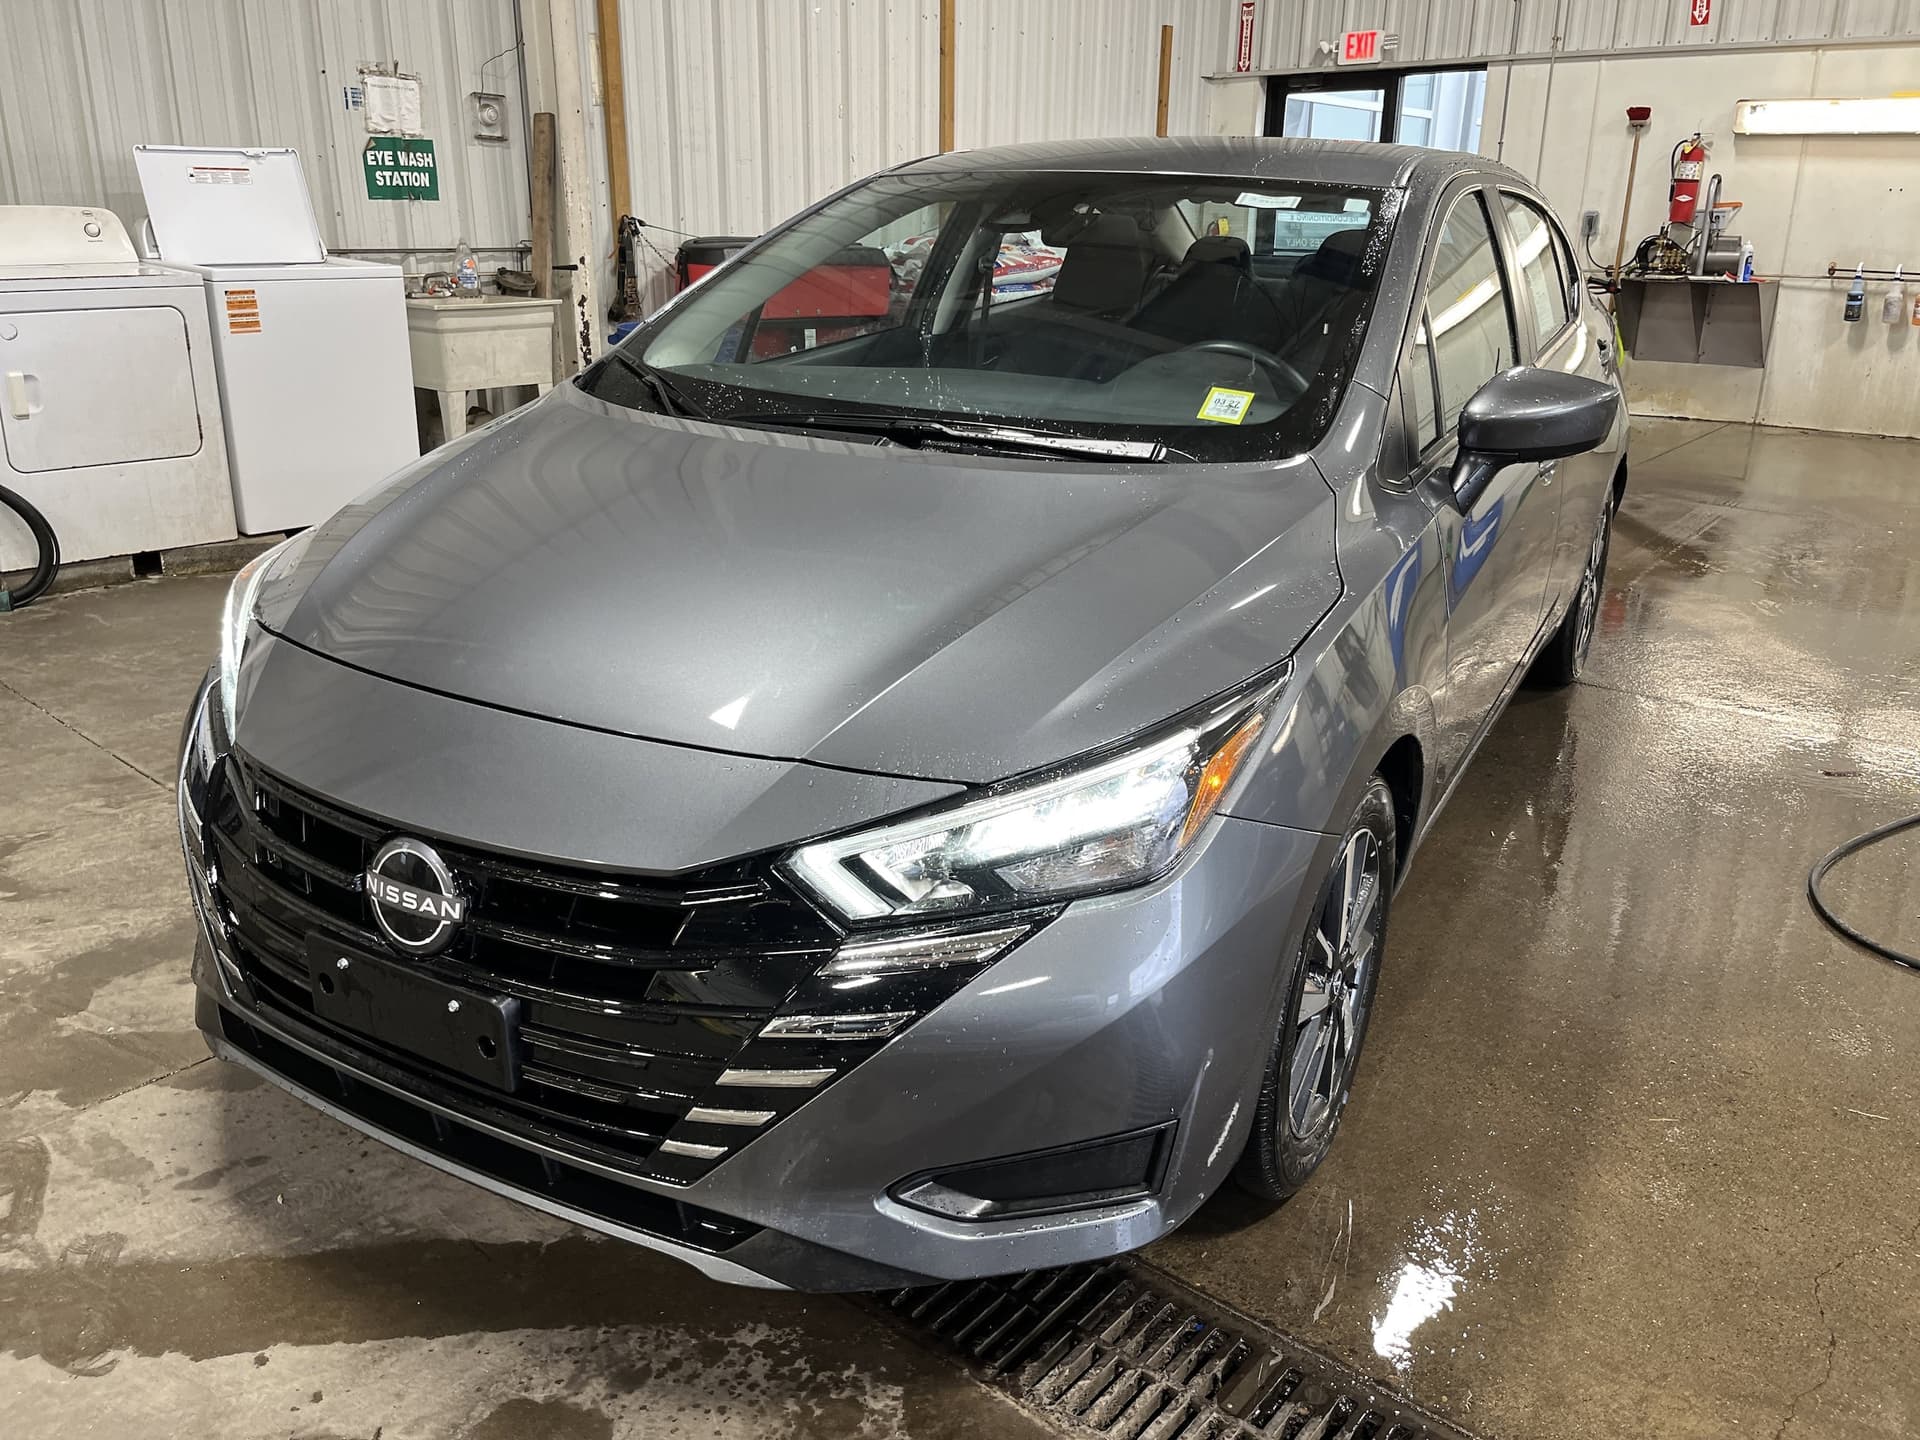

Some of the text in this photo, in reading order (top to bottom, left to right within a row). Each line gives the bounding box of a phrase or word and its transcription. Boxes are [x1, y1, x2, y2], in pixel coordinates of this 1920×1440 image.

[1345, 31, 1377, 60] EXIT
[366, 150, 433, 168] EYE WASH
[375, 170, 430, 187] STATION
[366, 873, 461, 919] NISSAN
